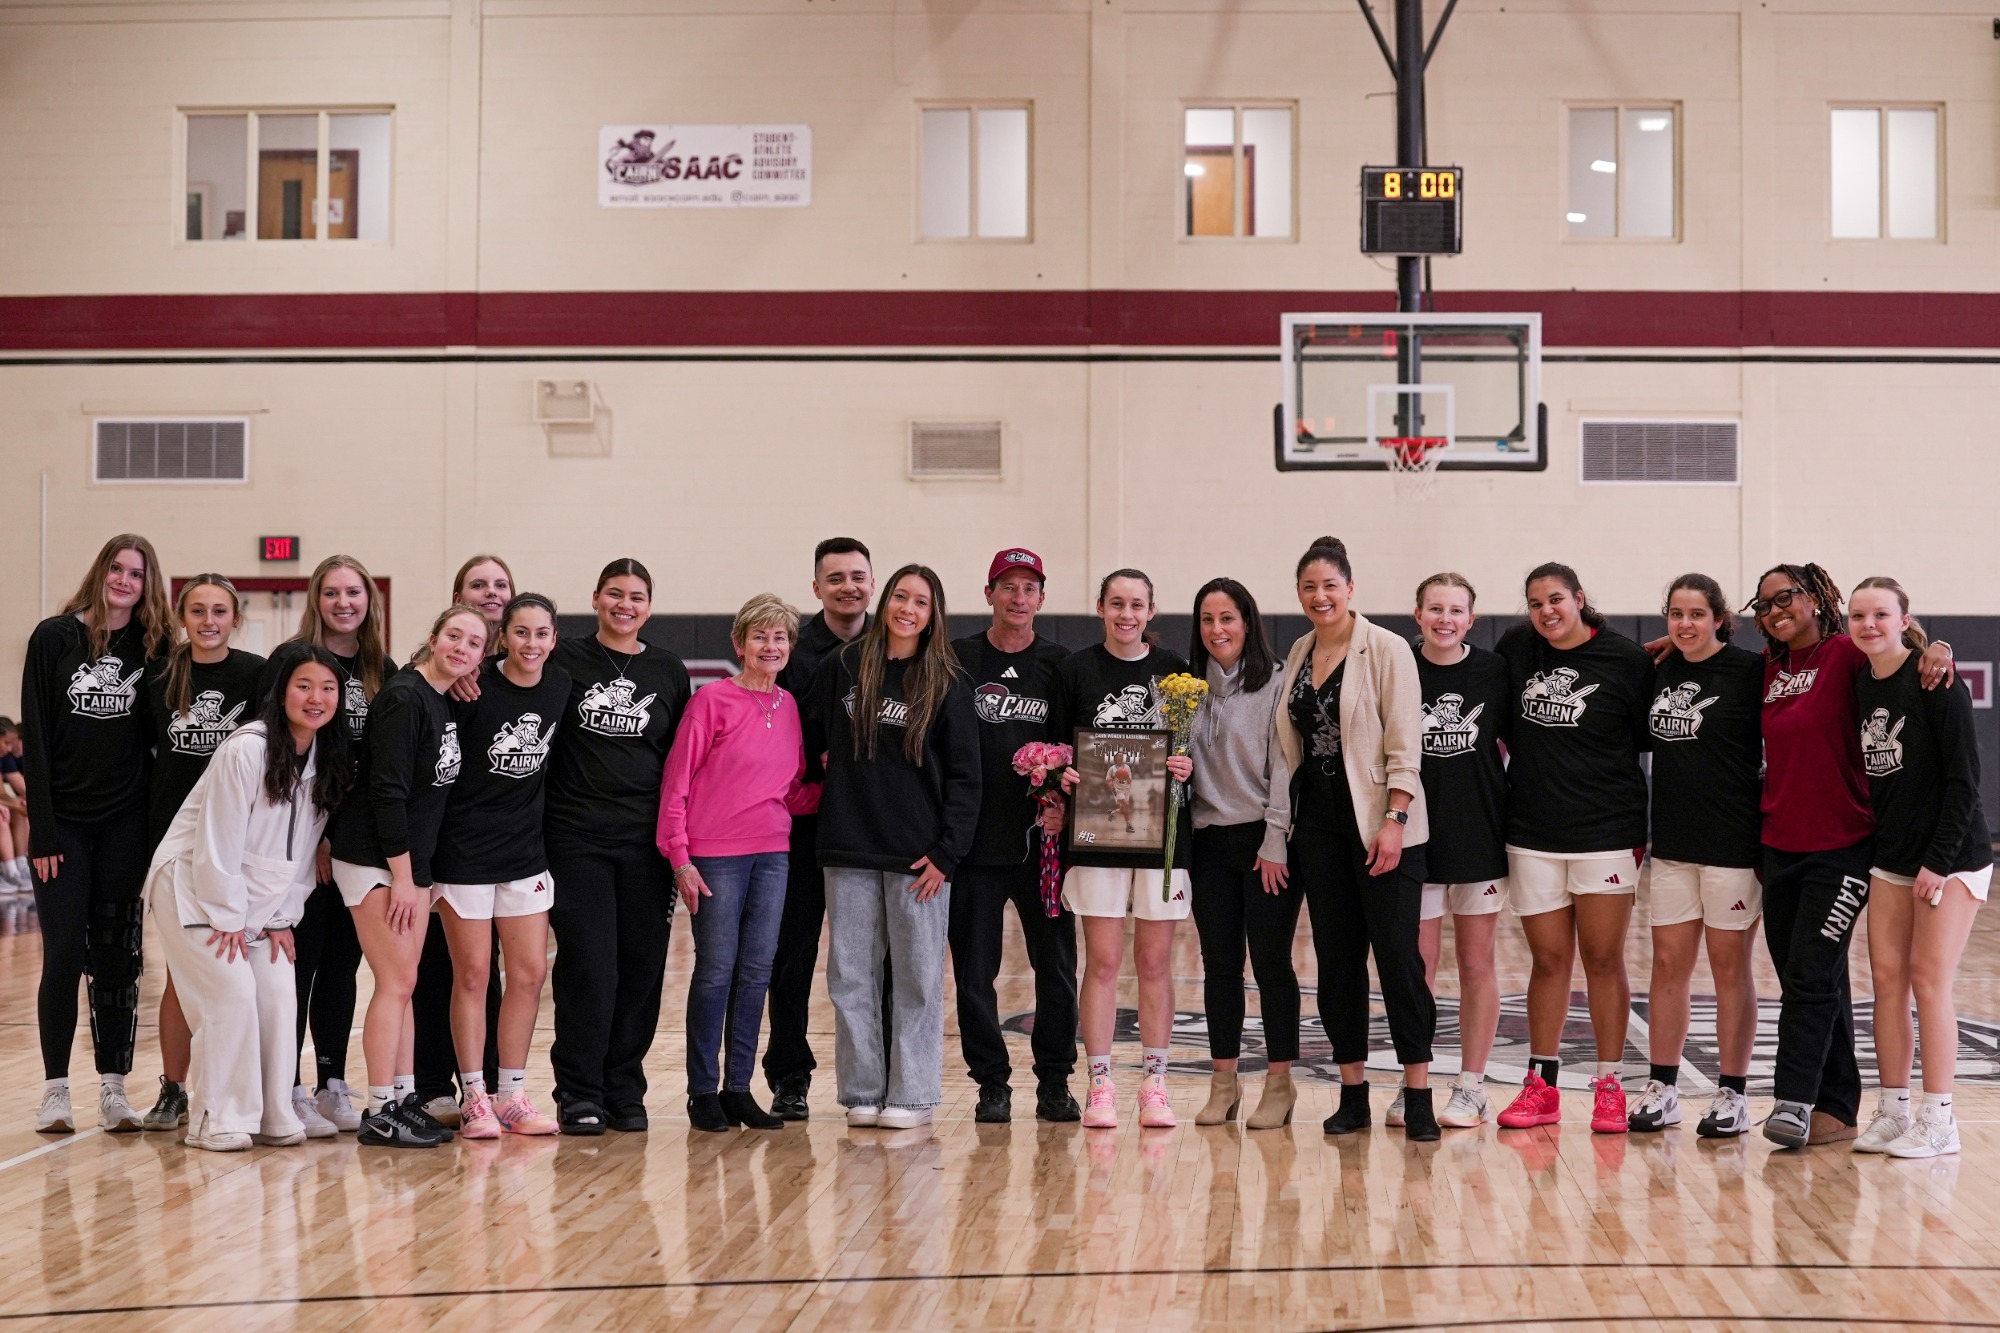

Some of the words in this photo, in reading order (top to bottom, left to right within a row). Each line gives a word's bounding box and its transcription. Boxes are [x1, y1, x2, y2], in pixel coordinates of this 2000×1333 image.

[661, 156, 743, 179] SAAC
[265, 537, 292, 560] EXIT
[81, 695, 125, 712] CAIRN
[1000, 696, 1047, 717] CAIRN
[1529, 701, 1571, 722] CAIRN
[590, 711, 637, 733] CAIRN
[1652, 716, 1690, 735] CAIRN
[1423, 733, 1467, 751] CAIRN
[500, 755, 540, 771] CAIRN
[1864, 751, 1896, 770] CAIRN
[1078, 830, 1097, 844] #12
[1820, 875, 1868, 942] CAIRN
